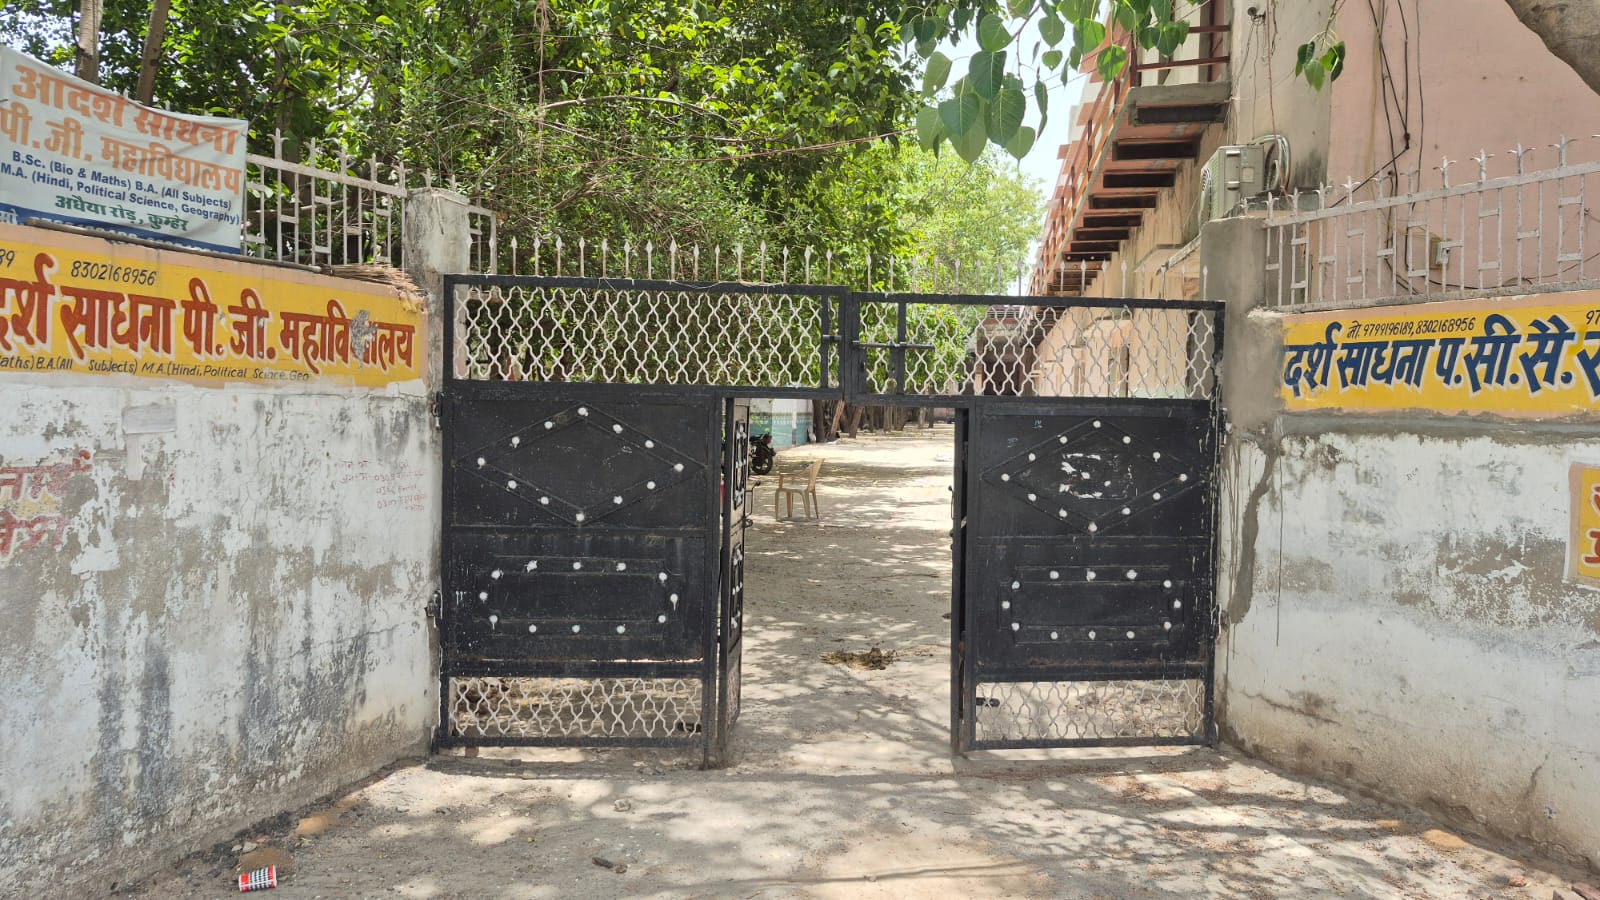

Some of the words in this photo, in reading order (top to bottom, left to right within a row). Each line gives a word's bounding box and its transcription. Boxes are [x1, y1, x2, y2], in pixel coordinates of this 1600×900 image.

[133, 104, 239, 155] साधना
[0, 162, 28, 179] M.A.
[32, 170, 73, 191] (Hindi,
[77, 182, 126, 201] Political
[129, 192, 178, 212] Science,
[181, 204, 239, 225] Geography)
[13, 150, 45, 168] B.Sc.
[50, 160, 73, 176] (Bio
[78, 168, 87, 178] &
[91, 171, 131, 190] Maths)
[135, 180, 158, 194] B.A.
[161, 187, 179, 199] (All
[182, 191, 232, 211] Subjects)
[71, 260, 157, 286] 8302168956
[60, 285, 176, 360] साधना
[280, 299, 415, 375] महाविालय
[0, 355, 34, 371] aths)
[1337, 339, 1435, 389] साधना
